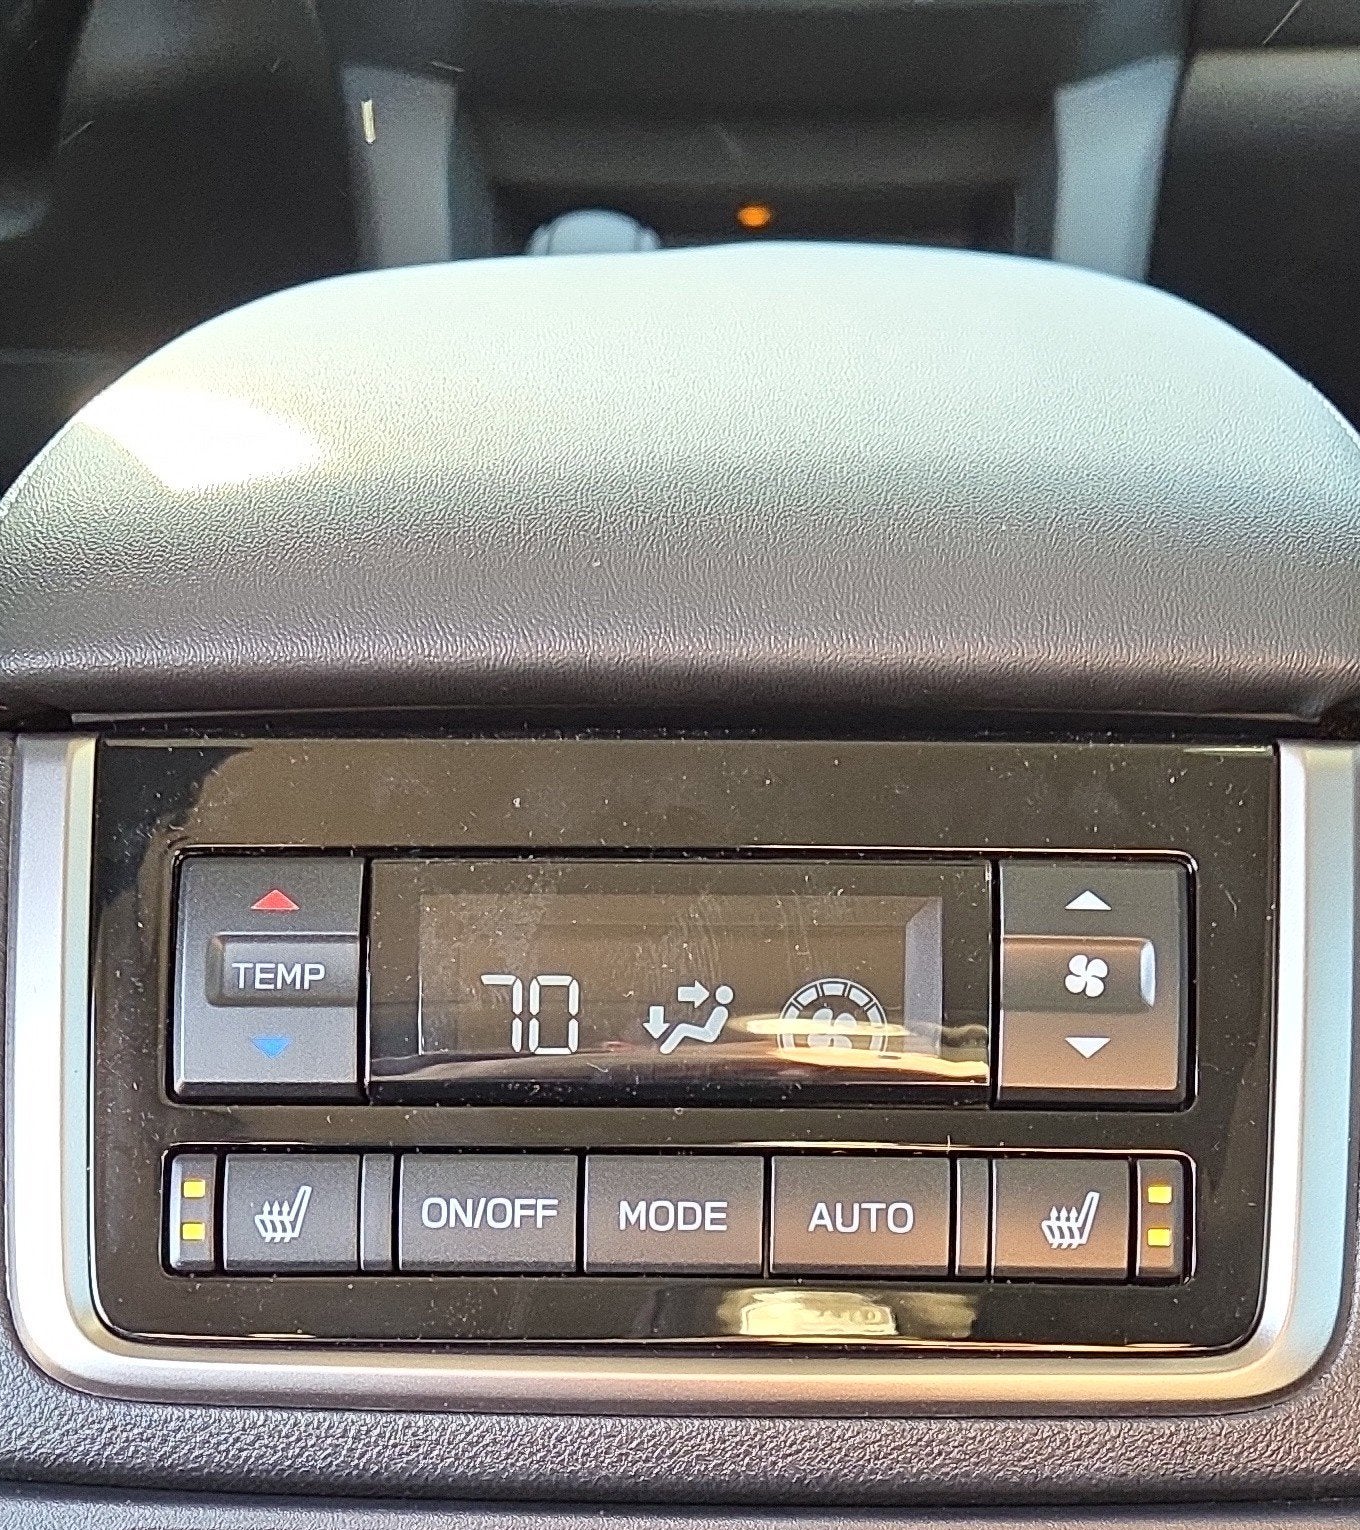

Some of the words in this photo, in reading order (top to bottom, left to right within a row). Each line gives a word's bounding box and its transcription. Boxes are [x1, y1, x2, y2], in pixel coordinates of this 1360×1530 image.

[233, 963, 326, 991] TEMP
[481, 974, 580, 1056] 70
[421, 1197, 559, 1230] ON/OFF
[618, 1200, 728, 1233] MODE
[807, 1202, 915, 1235] AUTO
